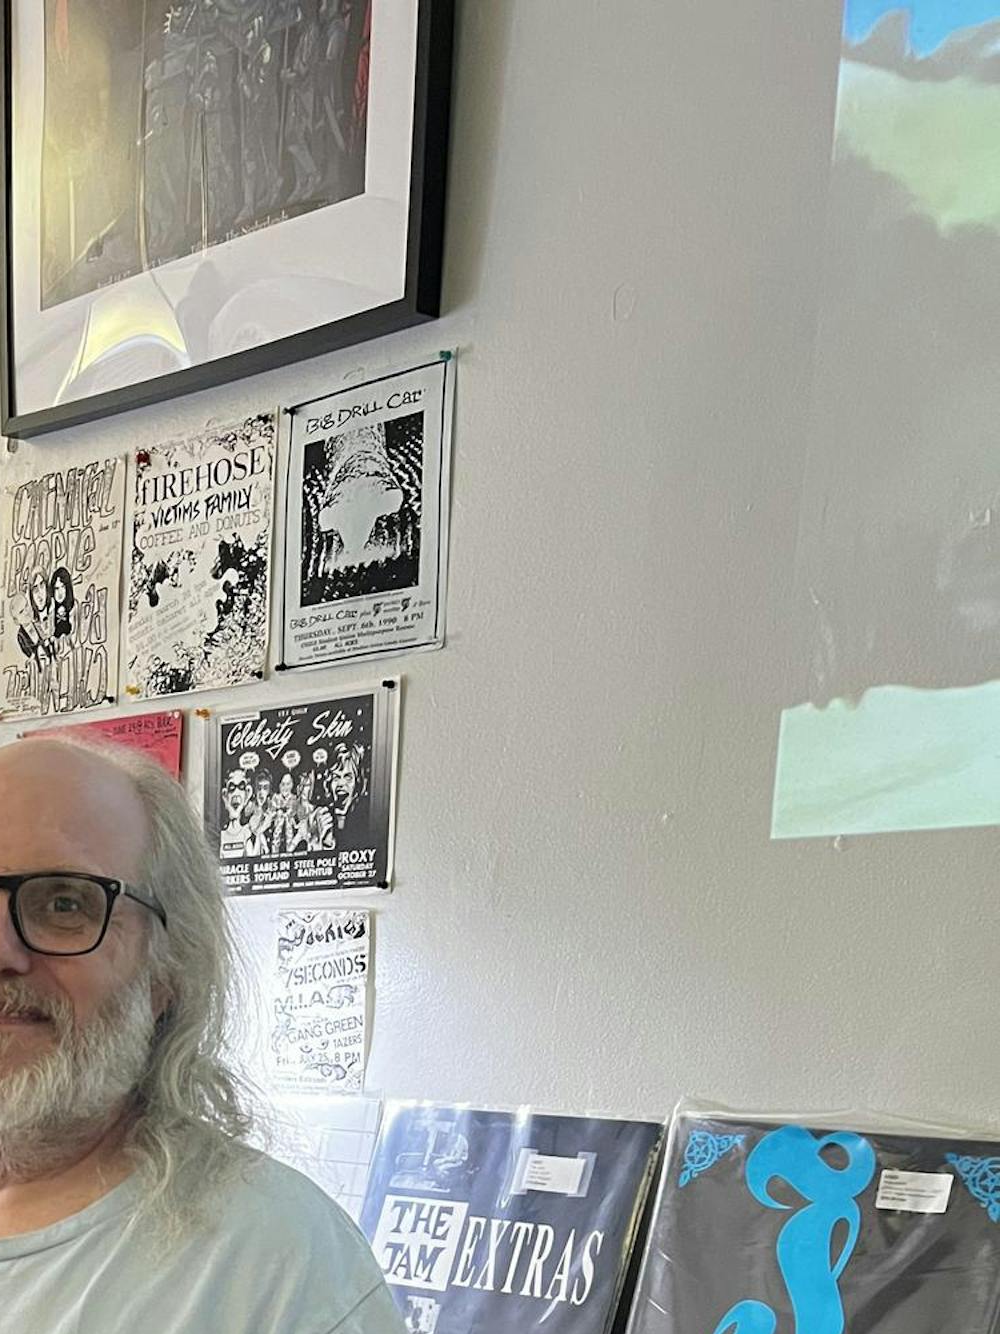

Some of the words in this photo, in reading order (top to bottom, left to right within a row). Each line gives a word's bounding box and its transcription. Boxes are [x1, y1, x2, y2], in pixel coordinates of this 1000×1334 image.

[150, 500, 200, 530] VICTIMS
[203, 484, 254, 521] FAMILY
[139, 526, 183, 551] COFFEE
[188, 521, 210, 539] AND
[215, 508, 262, 533] DONUTS
[226, 716, 300, 759] Celebrity
[306, 710, 353, 746] Skin
[293, 859, 316, 870] STEEL
[316, 857, 337, 867] POLE
[297, 867, 333, 878] BATHTUB
[342, 849, 376, 864] ROXY
[324, 1015, 364, 1036] GREEN
[390, 1200, 455, 1241] THE
[382, 1241, 445, 1283] JAM
[452, 1215, 604, 1324] EXTRAS
